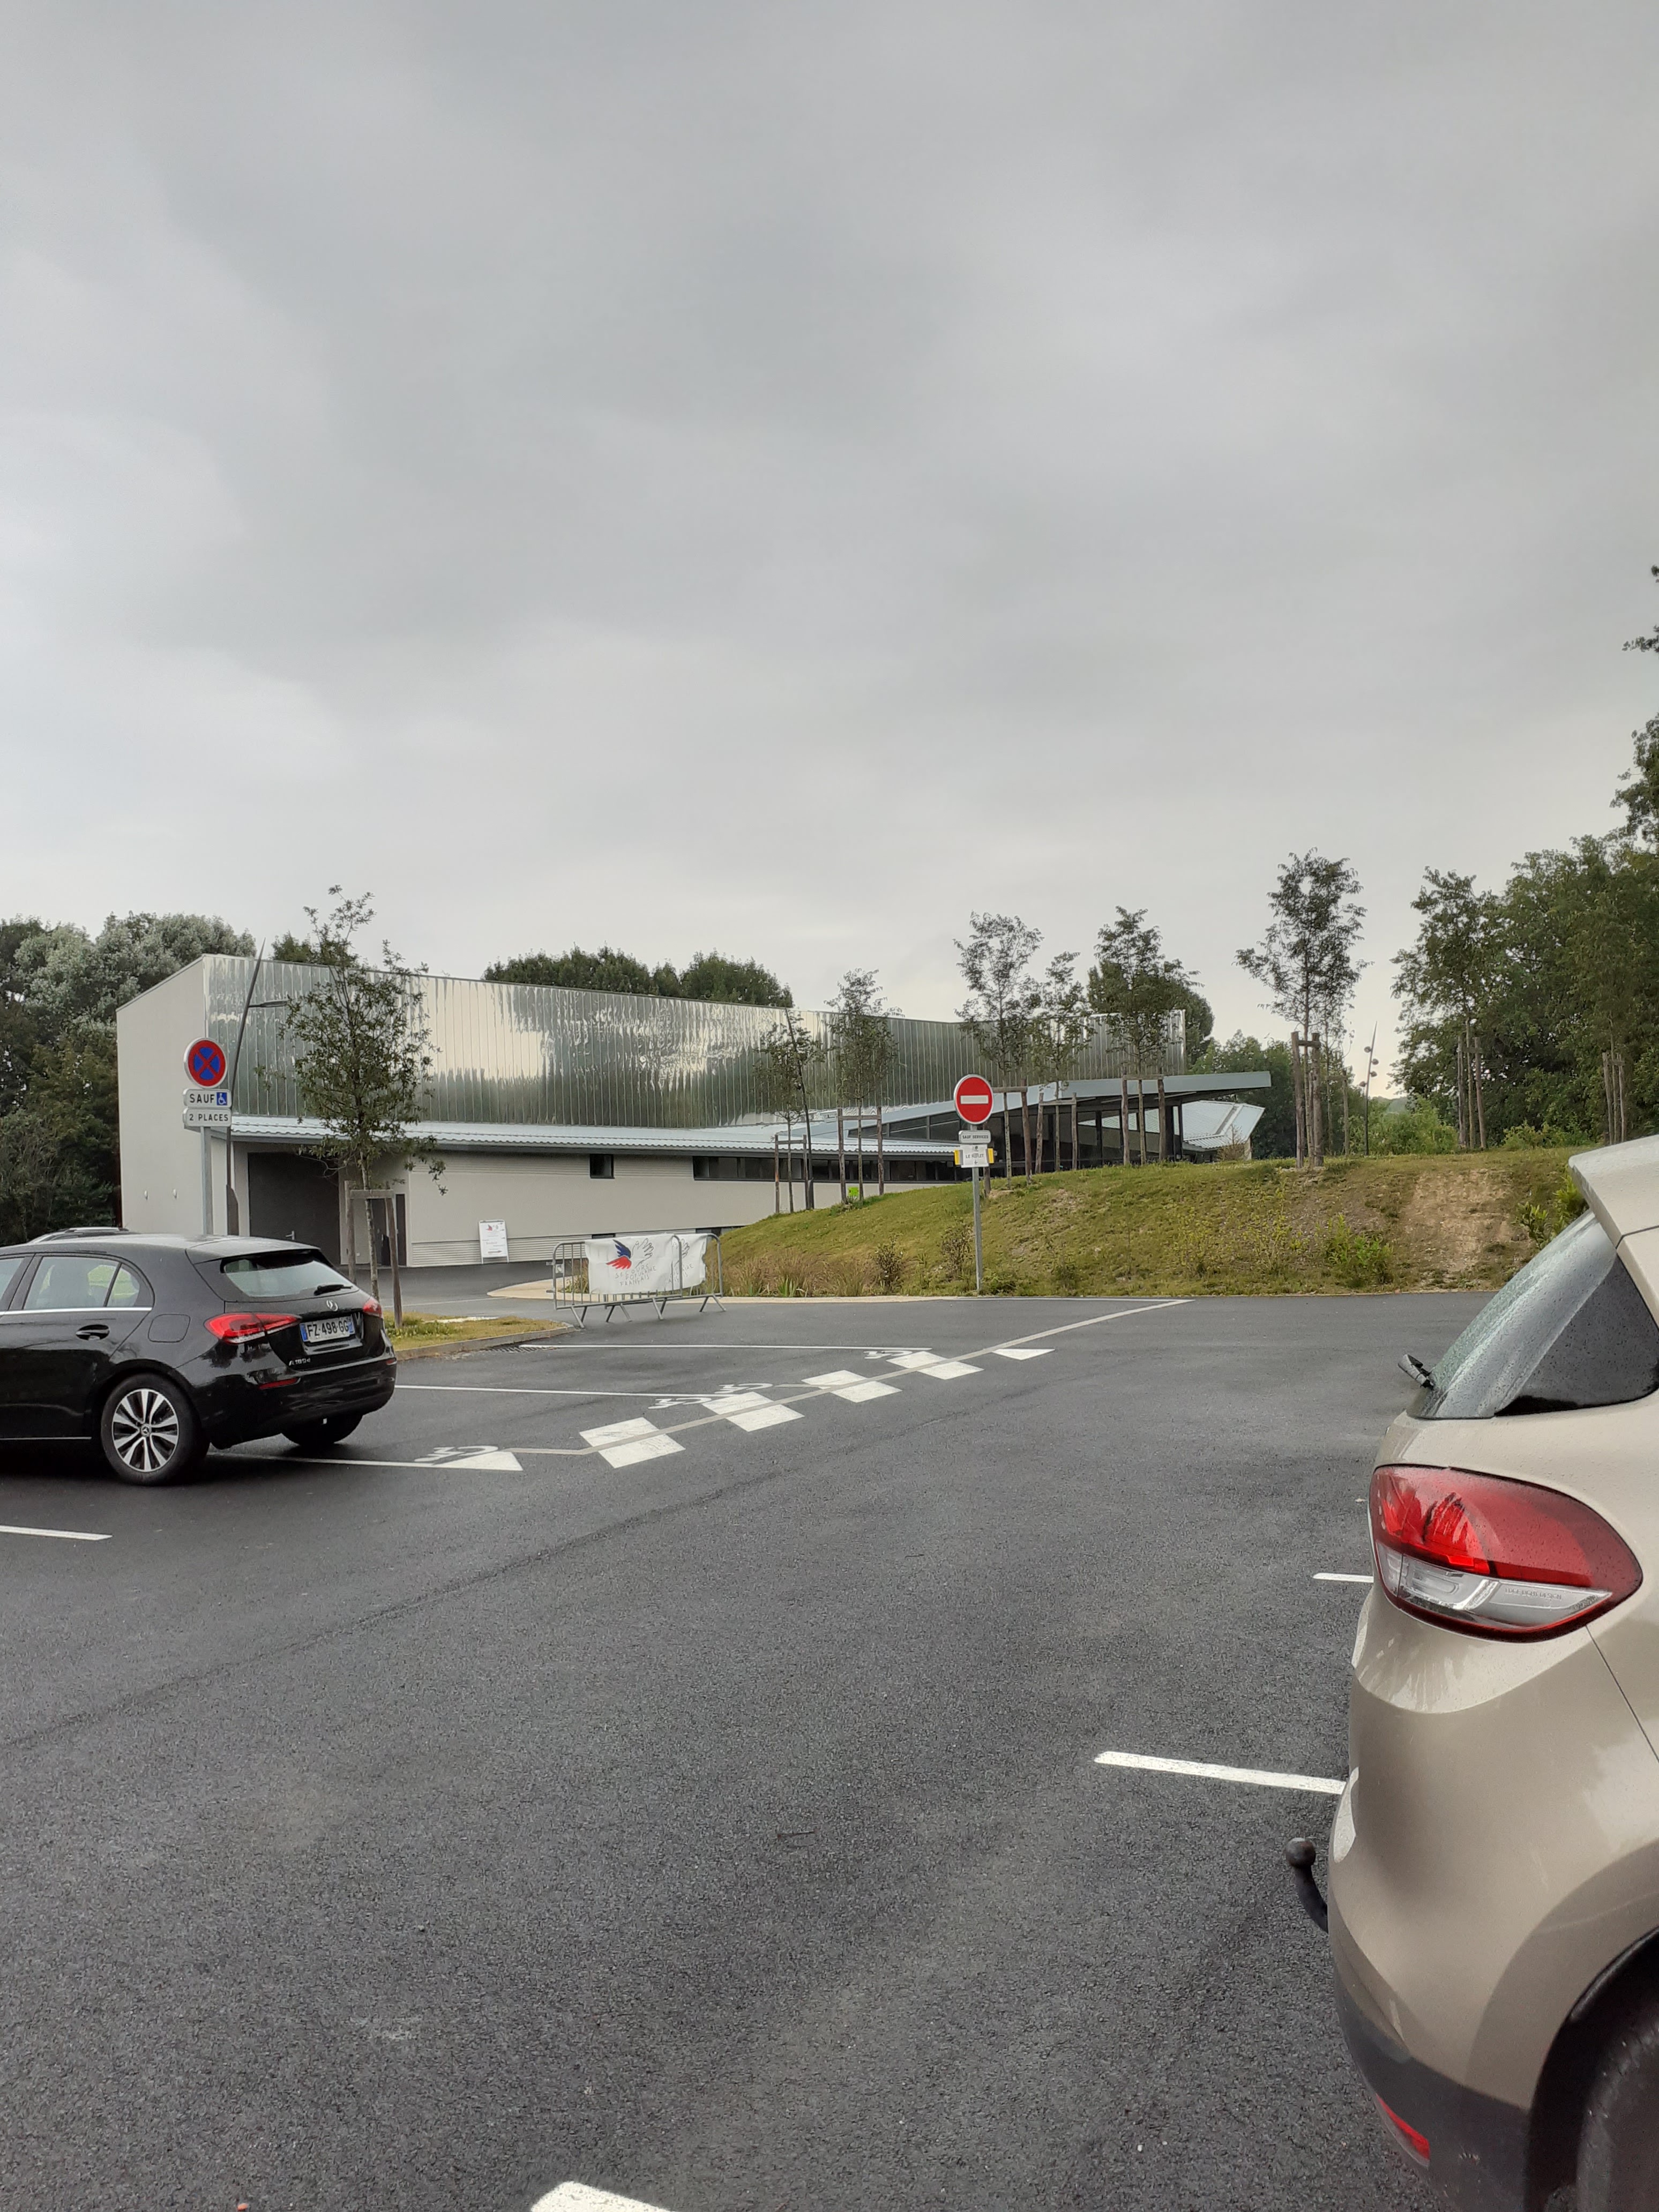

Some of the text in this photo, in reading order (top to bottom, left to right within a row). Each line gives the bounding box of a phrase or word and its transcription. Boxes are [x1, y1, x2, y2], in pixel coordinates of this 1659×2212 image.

[189, 1093, 215, 1103] SAUF
[198, 1114, 228, 1122] PLACES
[615, 1264, 649, 1279] SECOURS
[626, 1266, 656, 1280] POPULAIRE
[620, 1274, 649, 1286] FRANÇAIS
[307, 1320, 349, 1337] FZ-498-GG
